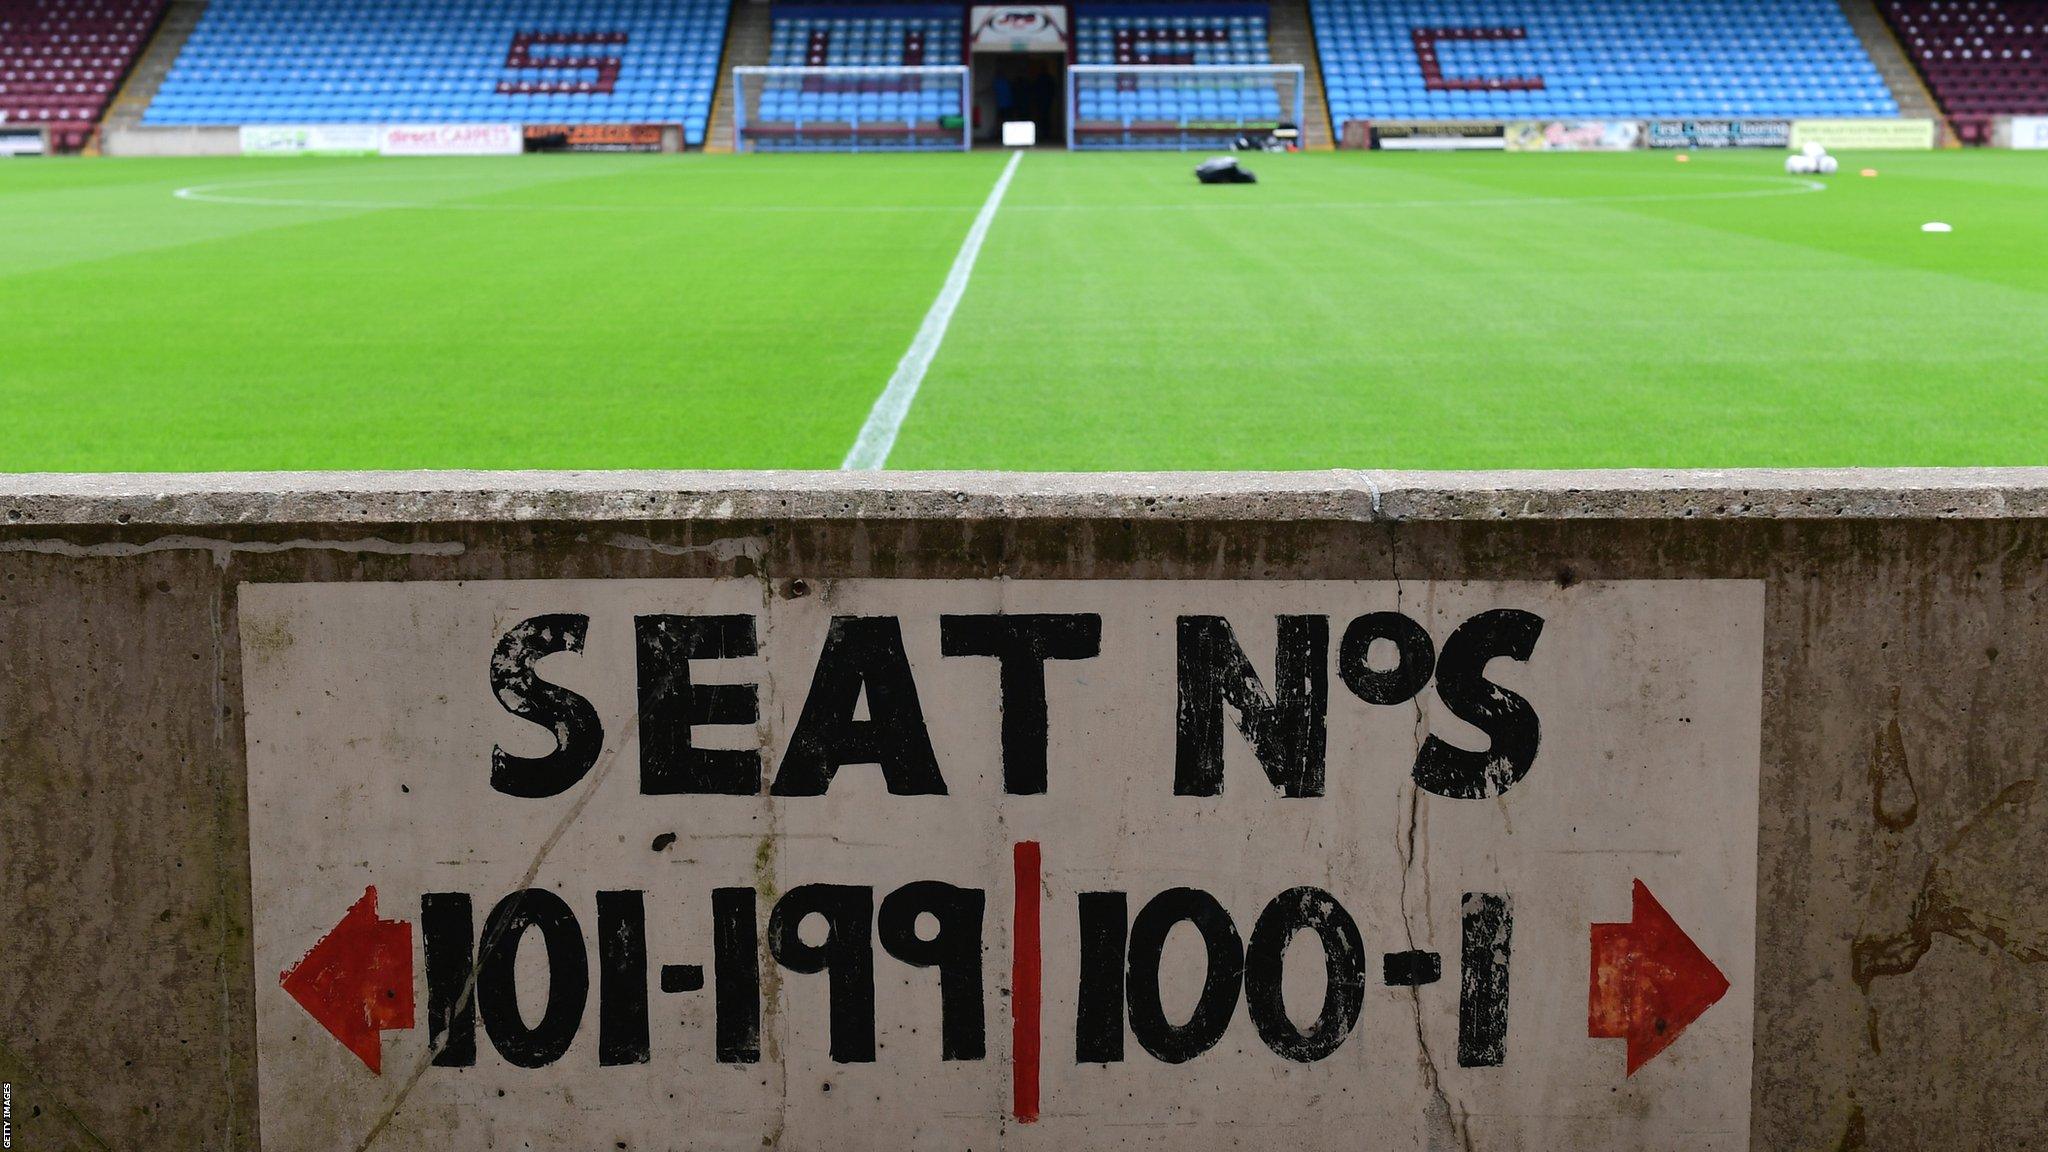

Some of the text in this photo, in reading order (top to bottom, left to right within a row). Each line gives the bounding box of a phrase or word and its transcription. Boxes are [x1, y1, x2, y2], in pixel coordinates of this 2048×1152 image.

[490, 612, 1102, 798] SEAT
[421, 880, 986, 1068] 101-199
[1076, 885, 1514, 1068] 100-1
